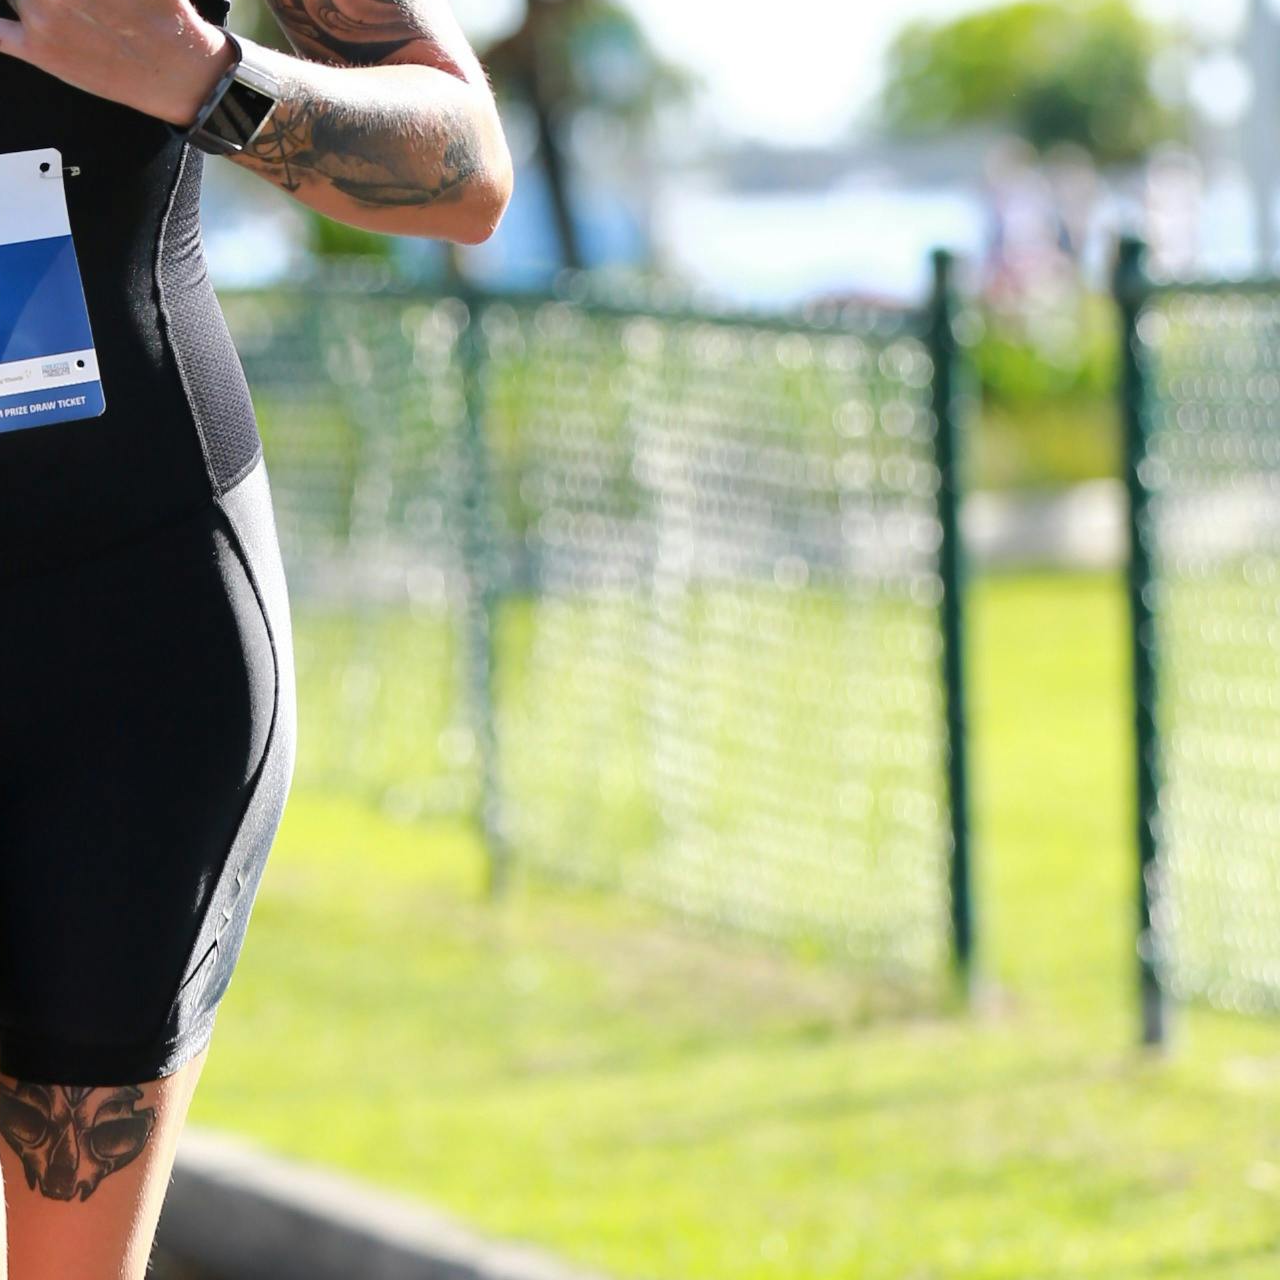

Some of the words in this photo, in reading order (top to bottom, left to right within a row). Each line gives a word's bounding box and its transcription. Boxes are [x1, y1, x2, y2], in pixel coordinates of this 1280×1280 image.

[4, 405, 28, 417] PRIZE
[29, 401, 56, 413] DRAW
[58, 396, 86, 408] TICKET
